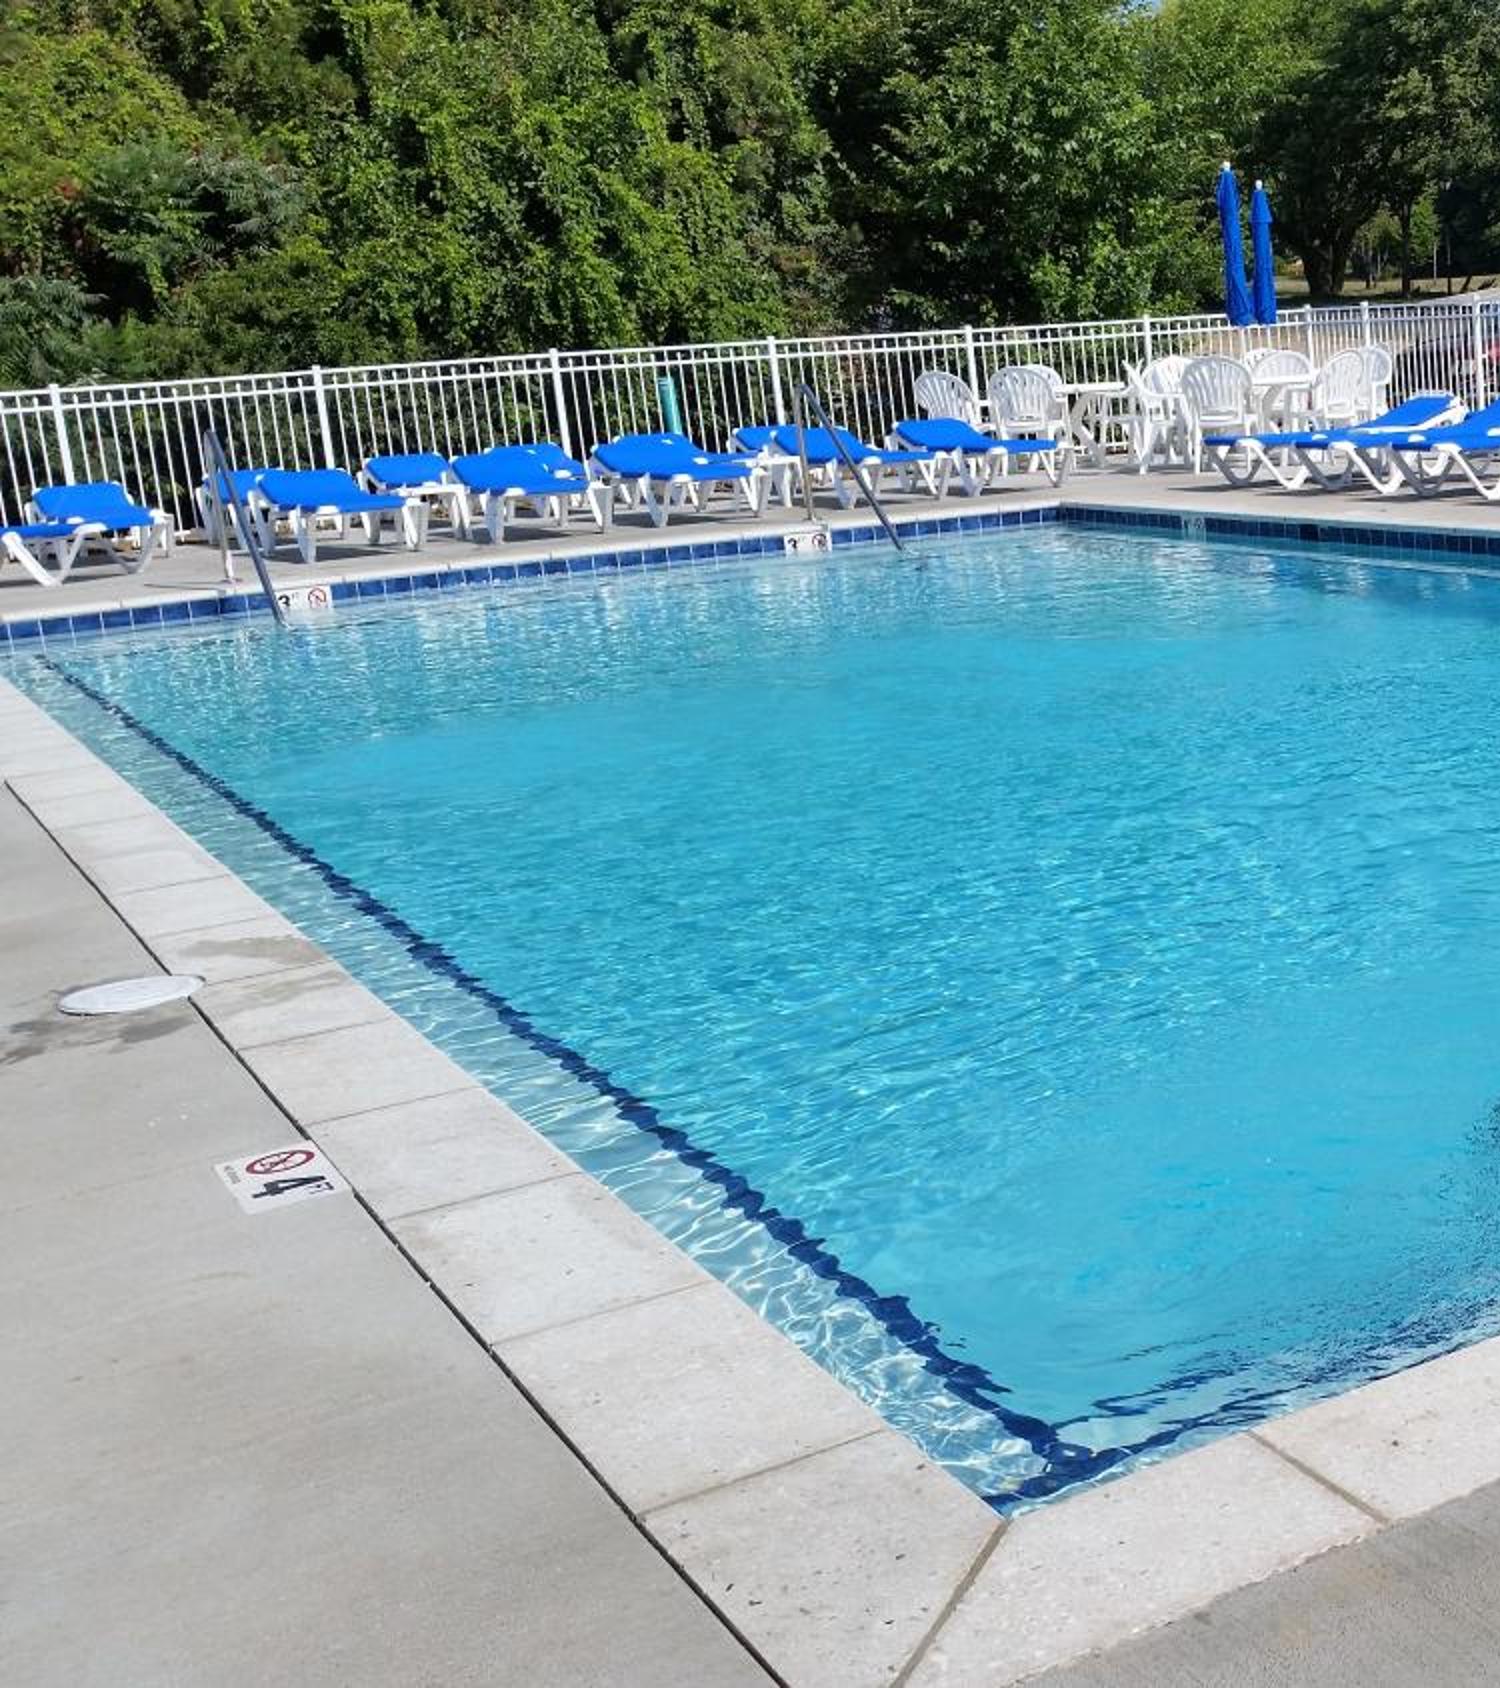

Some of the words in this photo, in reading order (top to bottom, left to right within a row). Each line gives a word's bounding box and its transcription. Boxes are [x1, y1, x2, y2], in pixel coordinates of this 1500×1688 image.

[278, 594, 291, 607] 3
[252, 1175, 327, 1199] 4
[304, 1181, 335, 1195] FT
